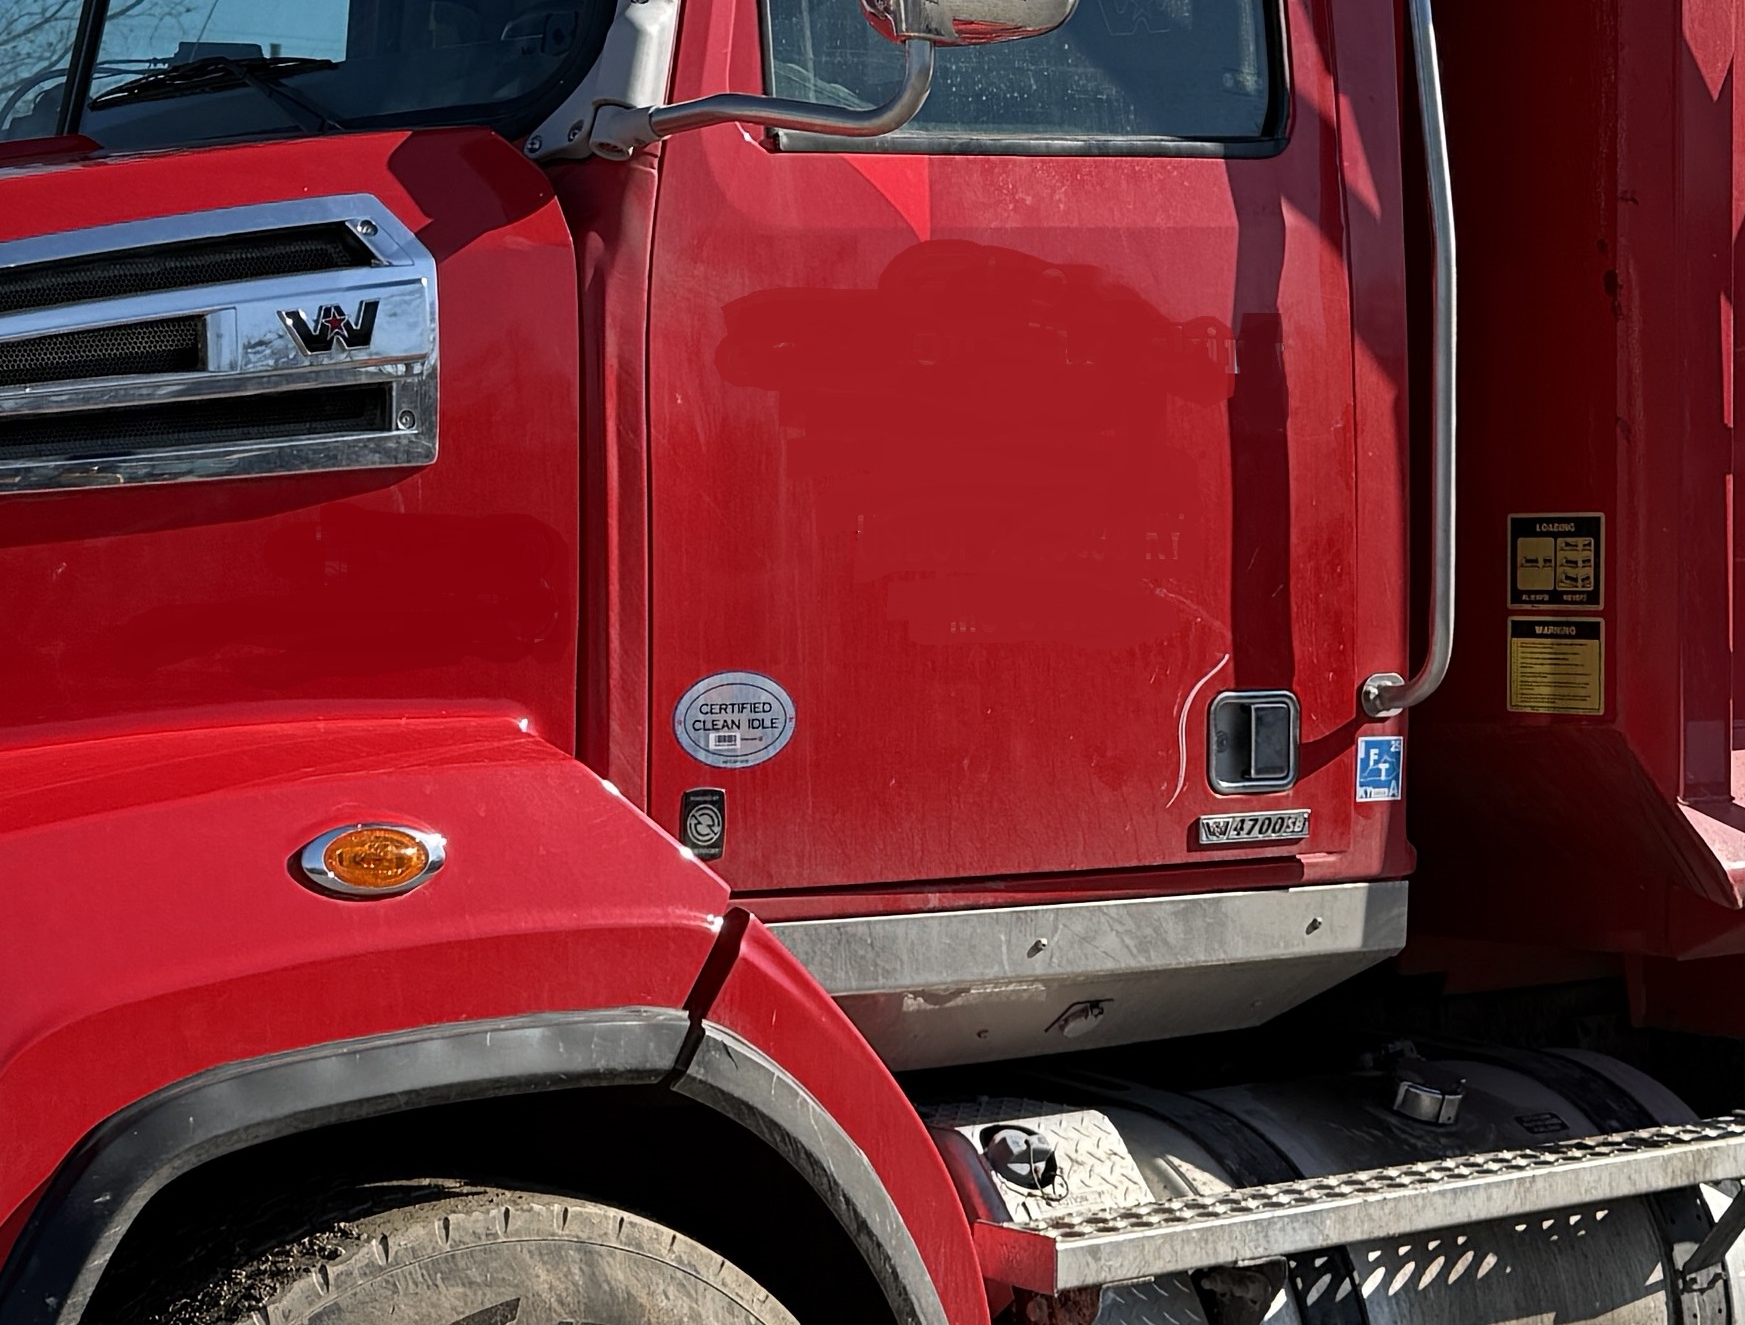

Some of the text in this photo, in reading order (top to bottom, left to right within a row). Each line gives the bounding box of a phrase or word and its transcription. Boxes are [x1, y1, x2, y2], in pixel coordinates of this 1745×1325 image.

[276, 297, 382, 356] W
[699, 702, 773, 715] CERTIFIED
[692, 718, 780, 731] CLEAN IDLE
